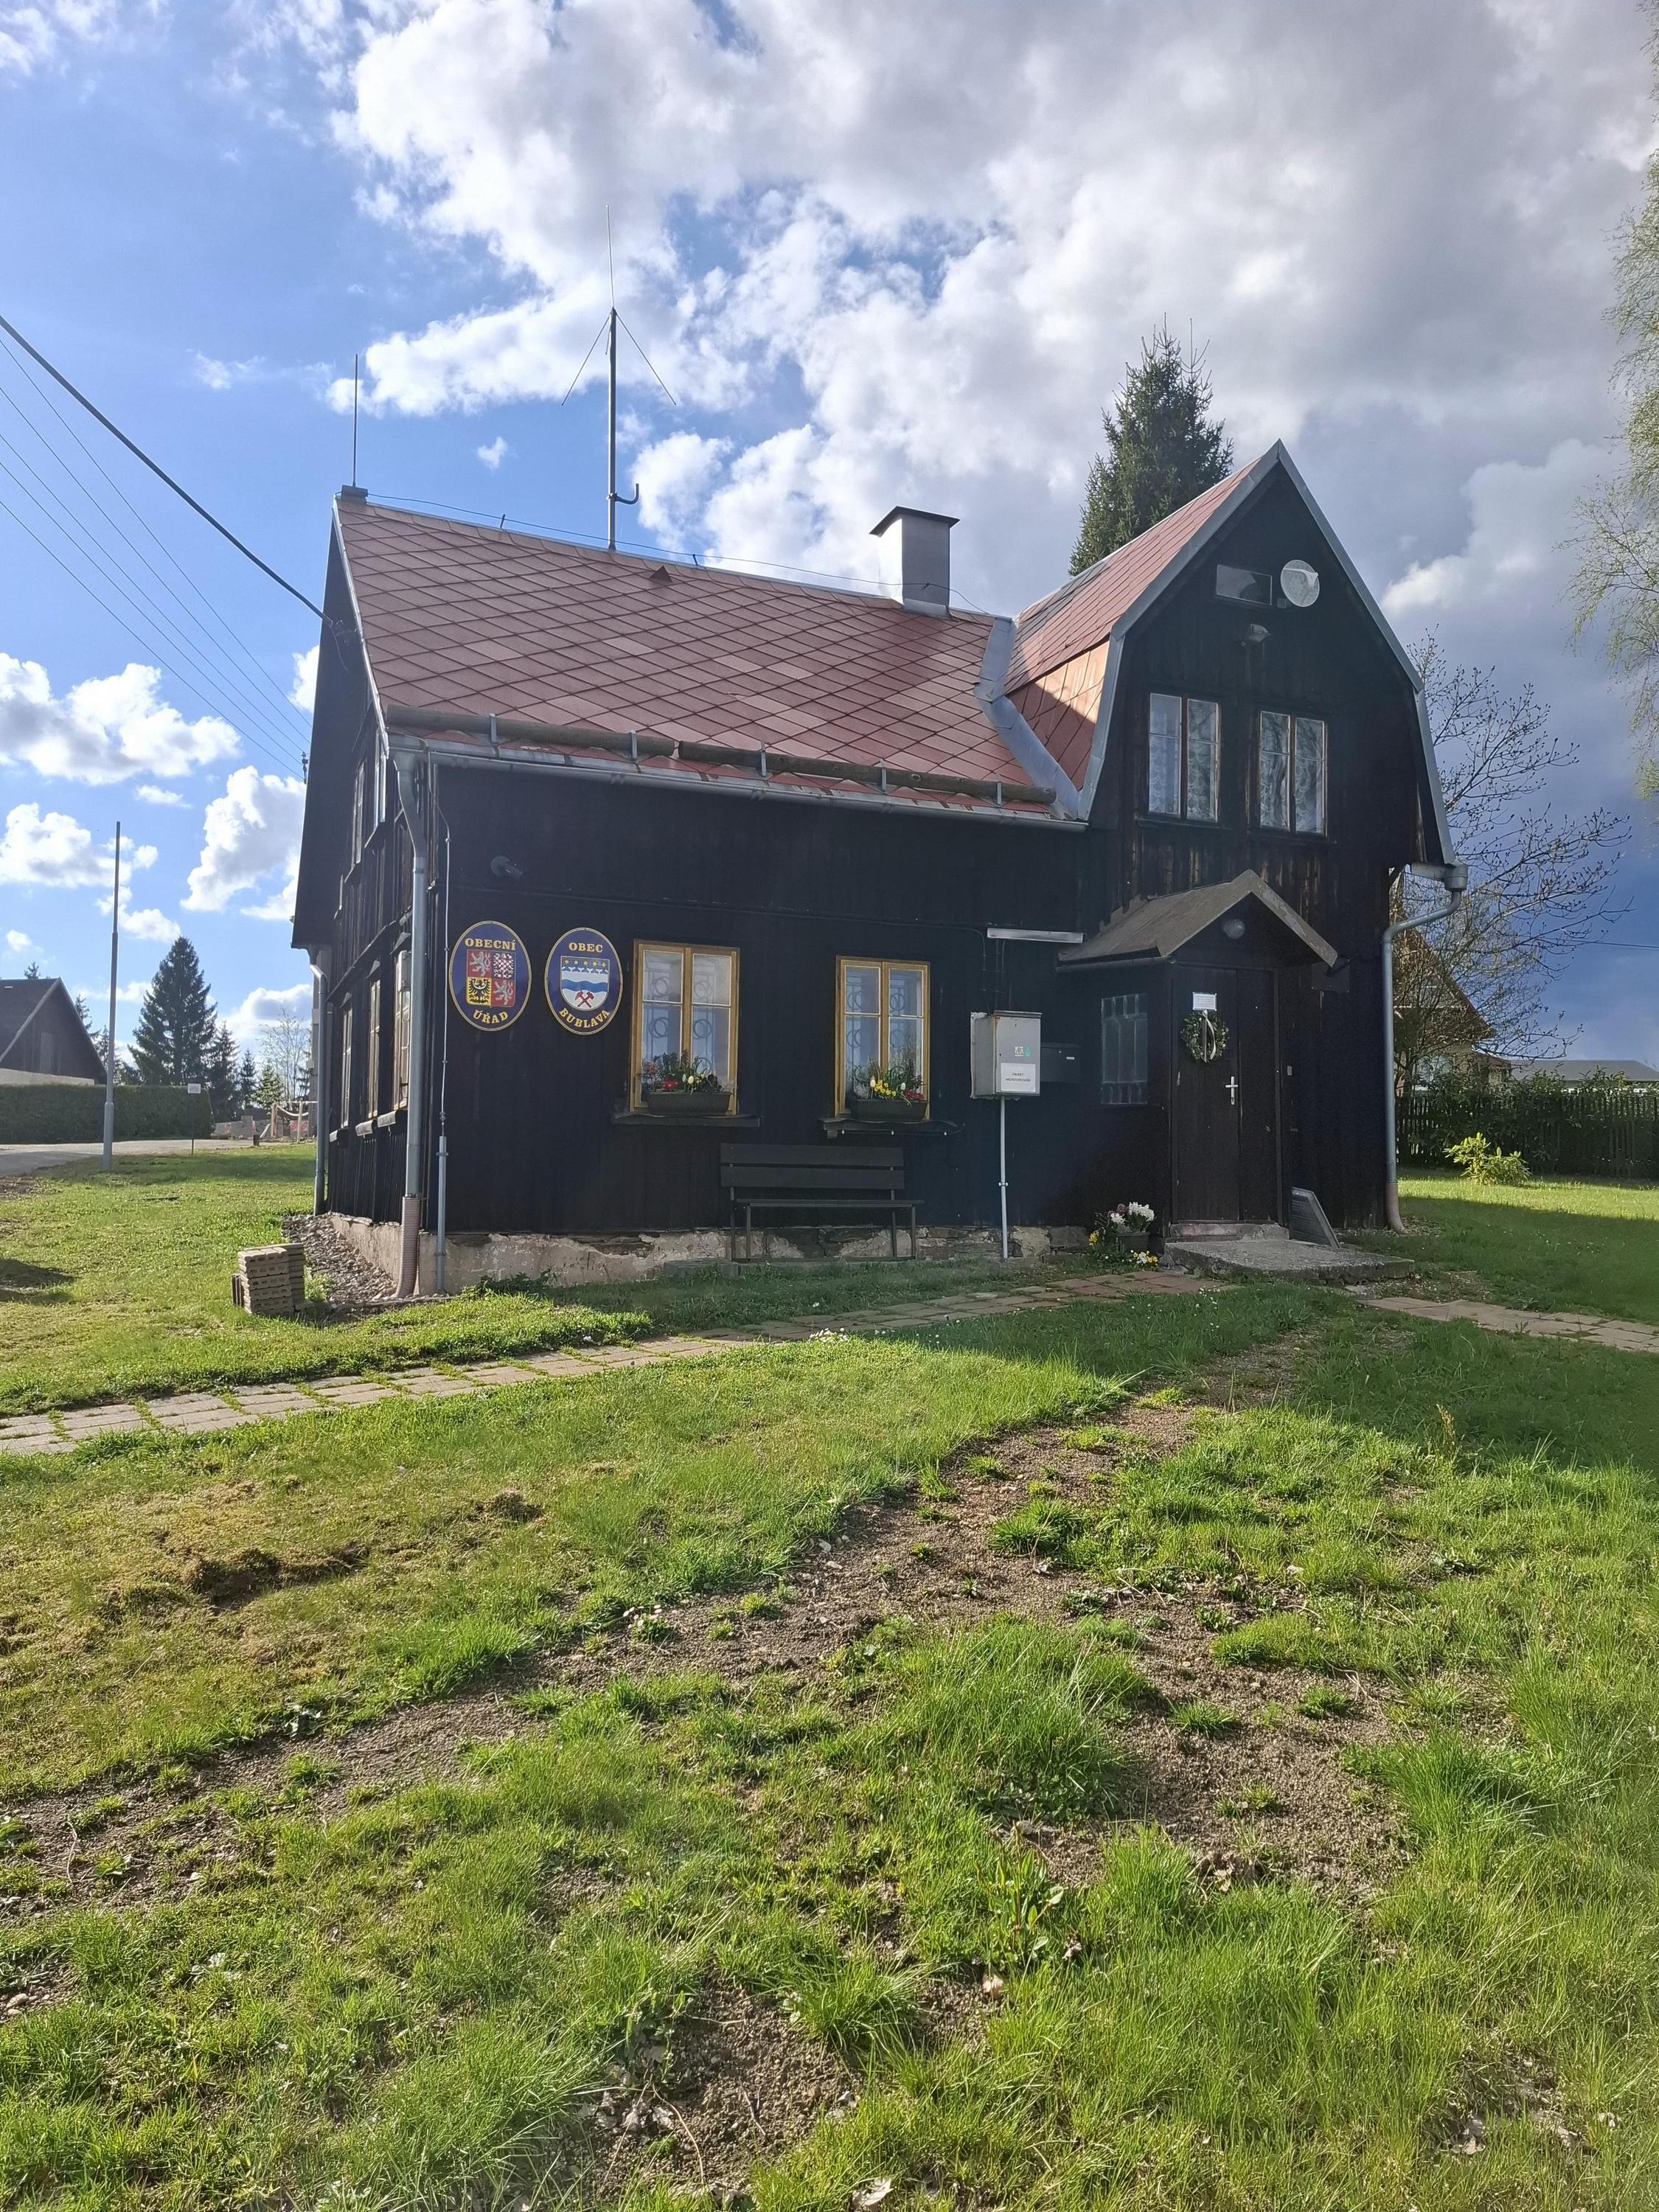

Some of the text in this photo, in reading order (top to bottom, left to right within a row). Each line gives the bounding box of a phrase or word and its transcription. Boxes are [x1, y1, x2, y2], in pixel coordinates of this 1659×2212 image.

[465, 938, 516, 950] OBECNÍ
[568, 942, 603, 953] OBEC
[473, 1009, 508, 1023] ÚŘAD
[559, 1007, 610, 1028] BUBLAVA
